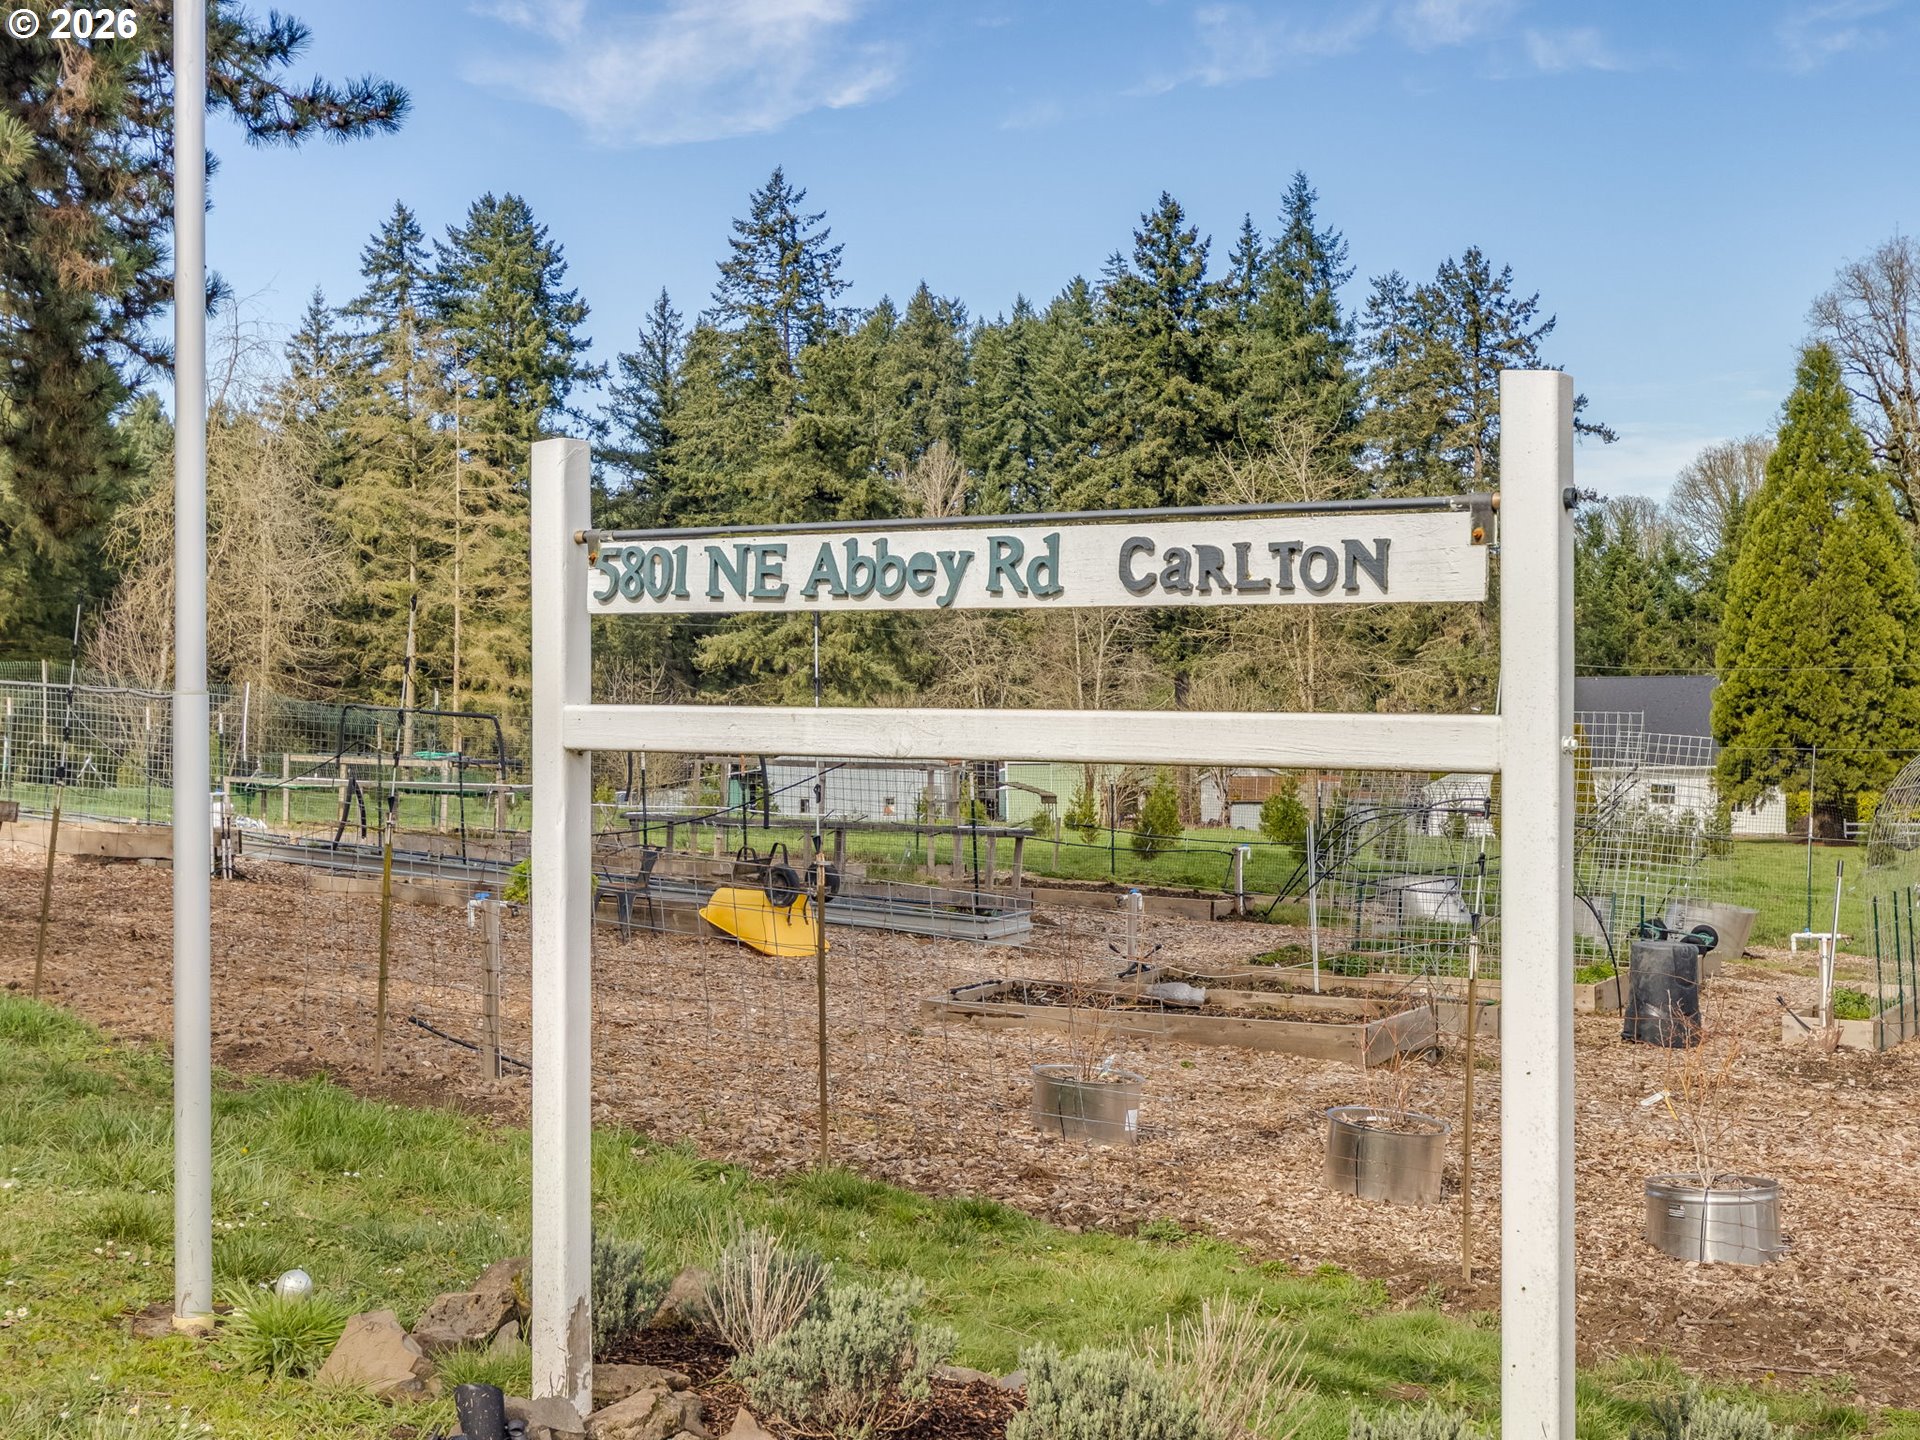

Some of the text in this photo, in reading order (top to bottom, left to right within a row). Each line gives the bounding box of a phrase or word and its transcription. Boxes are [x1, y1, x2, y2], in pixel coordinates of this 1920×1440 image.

[593, 544, 689, 601] 5801
[704, 543, 789, 599] NE
[800, 537, 975, 607] Abbey
[986, 532, 1064, 597] Rd
